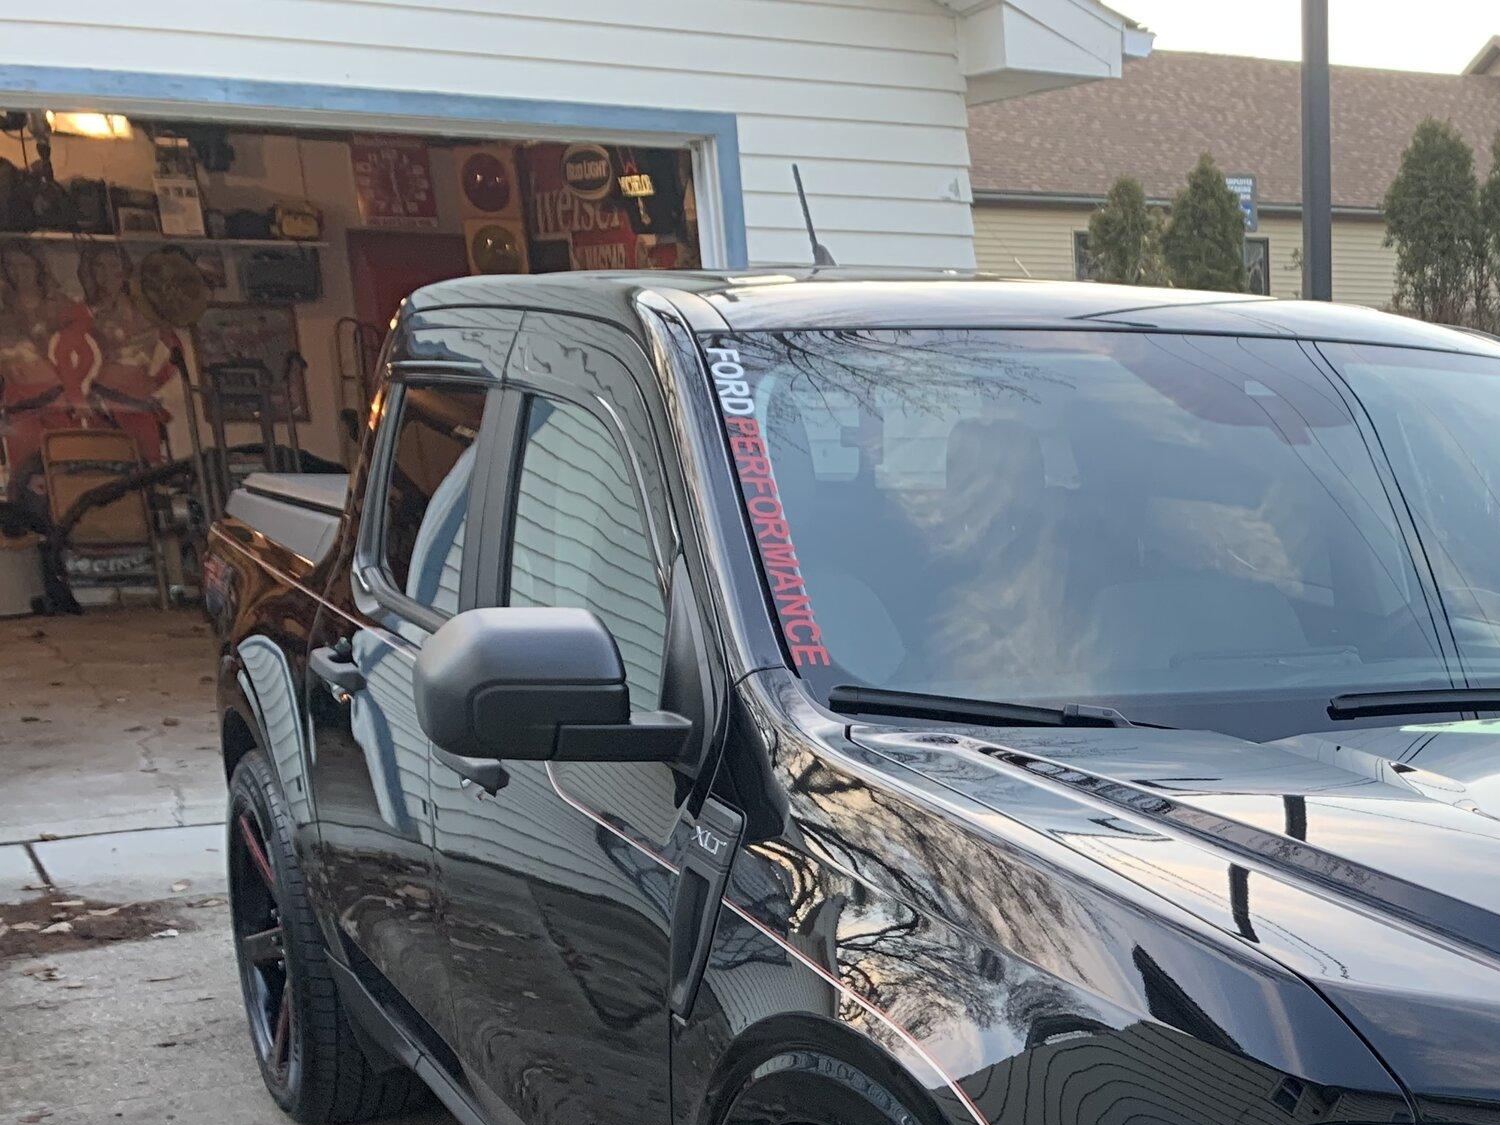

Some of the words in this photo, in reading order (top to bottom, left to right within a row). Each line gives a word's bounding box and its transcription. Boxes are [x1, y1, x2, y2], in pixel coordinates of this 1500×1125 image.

[584, 160, 608, 179] LIGHT
[706, 347, 756, 417] FORD
[728, 416, 830, 667] PERFORMANCE
[691, 825, 727, 855] XLT
